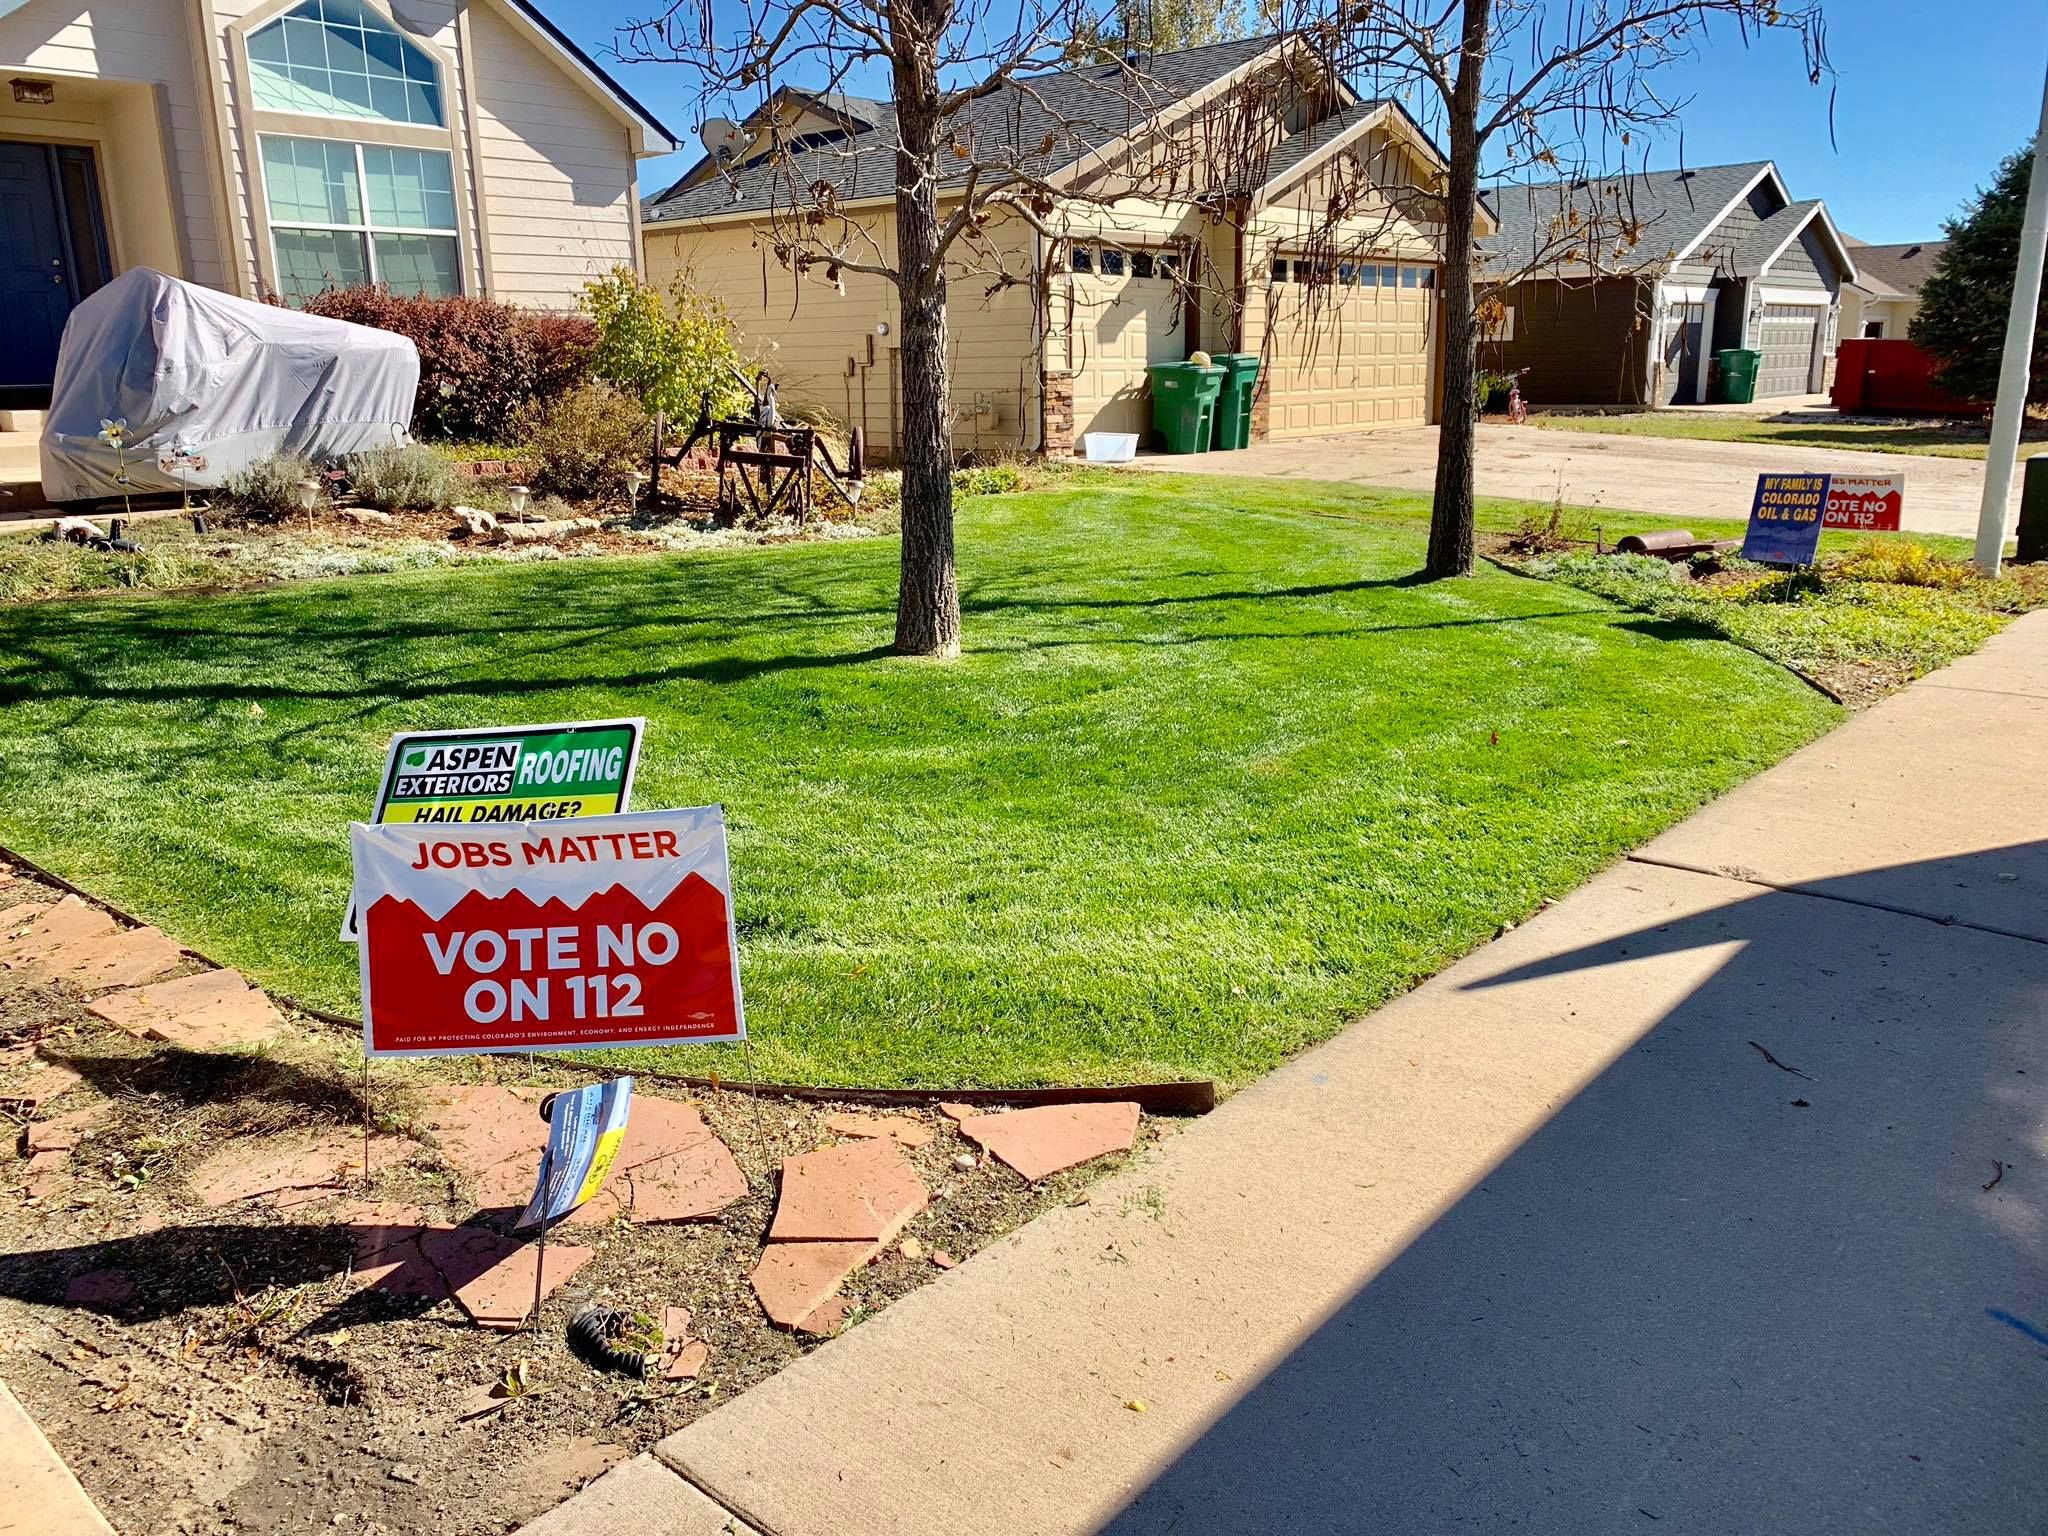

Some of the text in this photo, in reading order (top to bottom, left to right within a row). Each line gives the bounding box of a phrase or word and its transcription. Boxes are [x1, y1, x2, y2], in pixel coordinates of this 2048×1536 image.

[1765, 478, 1823, 491] MY FAMILY IS
[1848, 479, 1891, 487] MATTER
[1762, 492, 1820, 506] COLORADO
[1827, 499, 1887, 513] OTE NO
[1758, 506, 1817, 522] OIL & GAS
[1825, 511, 1875, 525] ON 112
[426, 745, 517, 771] ASPEN
[518, 746, 623, 785] ROOFING
[395, 773, 511, 796] EXTERIORS
[414, 801, 582, 823] HAIL DAMAGE?
[411, 830, 681, 870] JOBS MATTER
[422, 922, 680, 976] VOTE NO
[463, 973, 644, 1024] ON 112
[438, 1033, 480, 1041] PROTECTING
[482, 1032, 526, 1040] COLORADO'S
[663, 1022, 715, 1031] INDEPENDENCE
